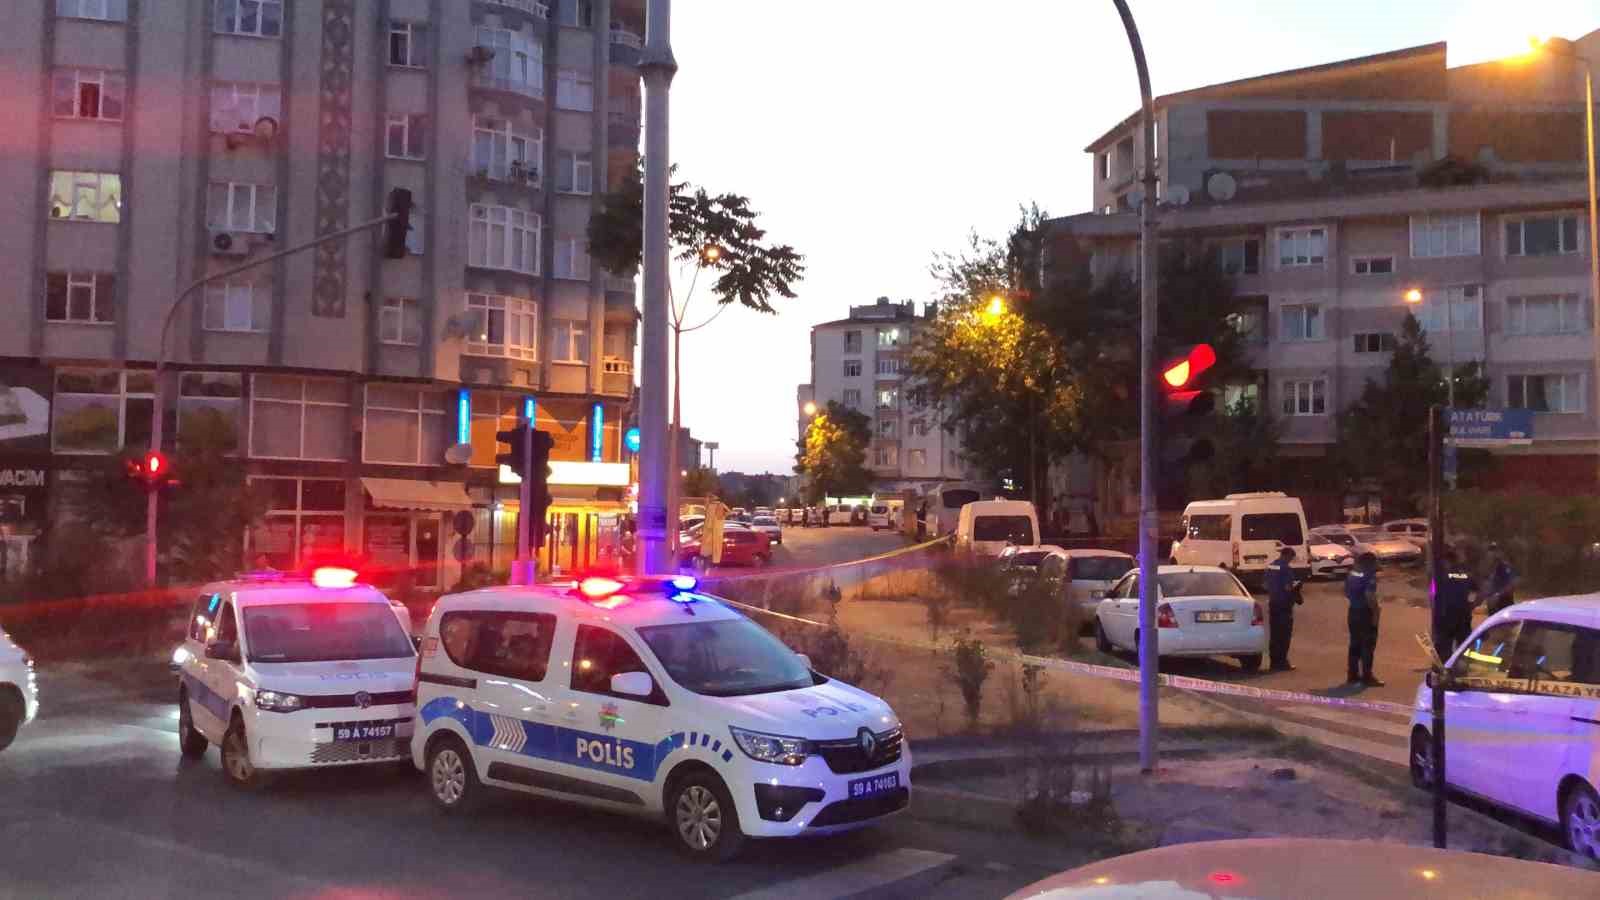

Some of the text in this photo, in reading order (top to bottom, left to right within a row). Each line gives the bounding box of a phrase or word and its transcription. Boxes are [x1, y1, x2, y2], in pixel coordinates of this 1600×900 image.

[1541, 684, 1582, 696] KAZA
[338, 726, 393, 739] 59 A 74157
[576, 736, 635, 769] POLİS
[866, 781, 873, 793] A
